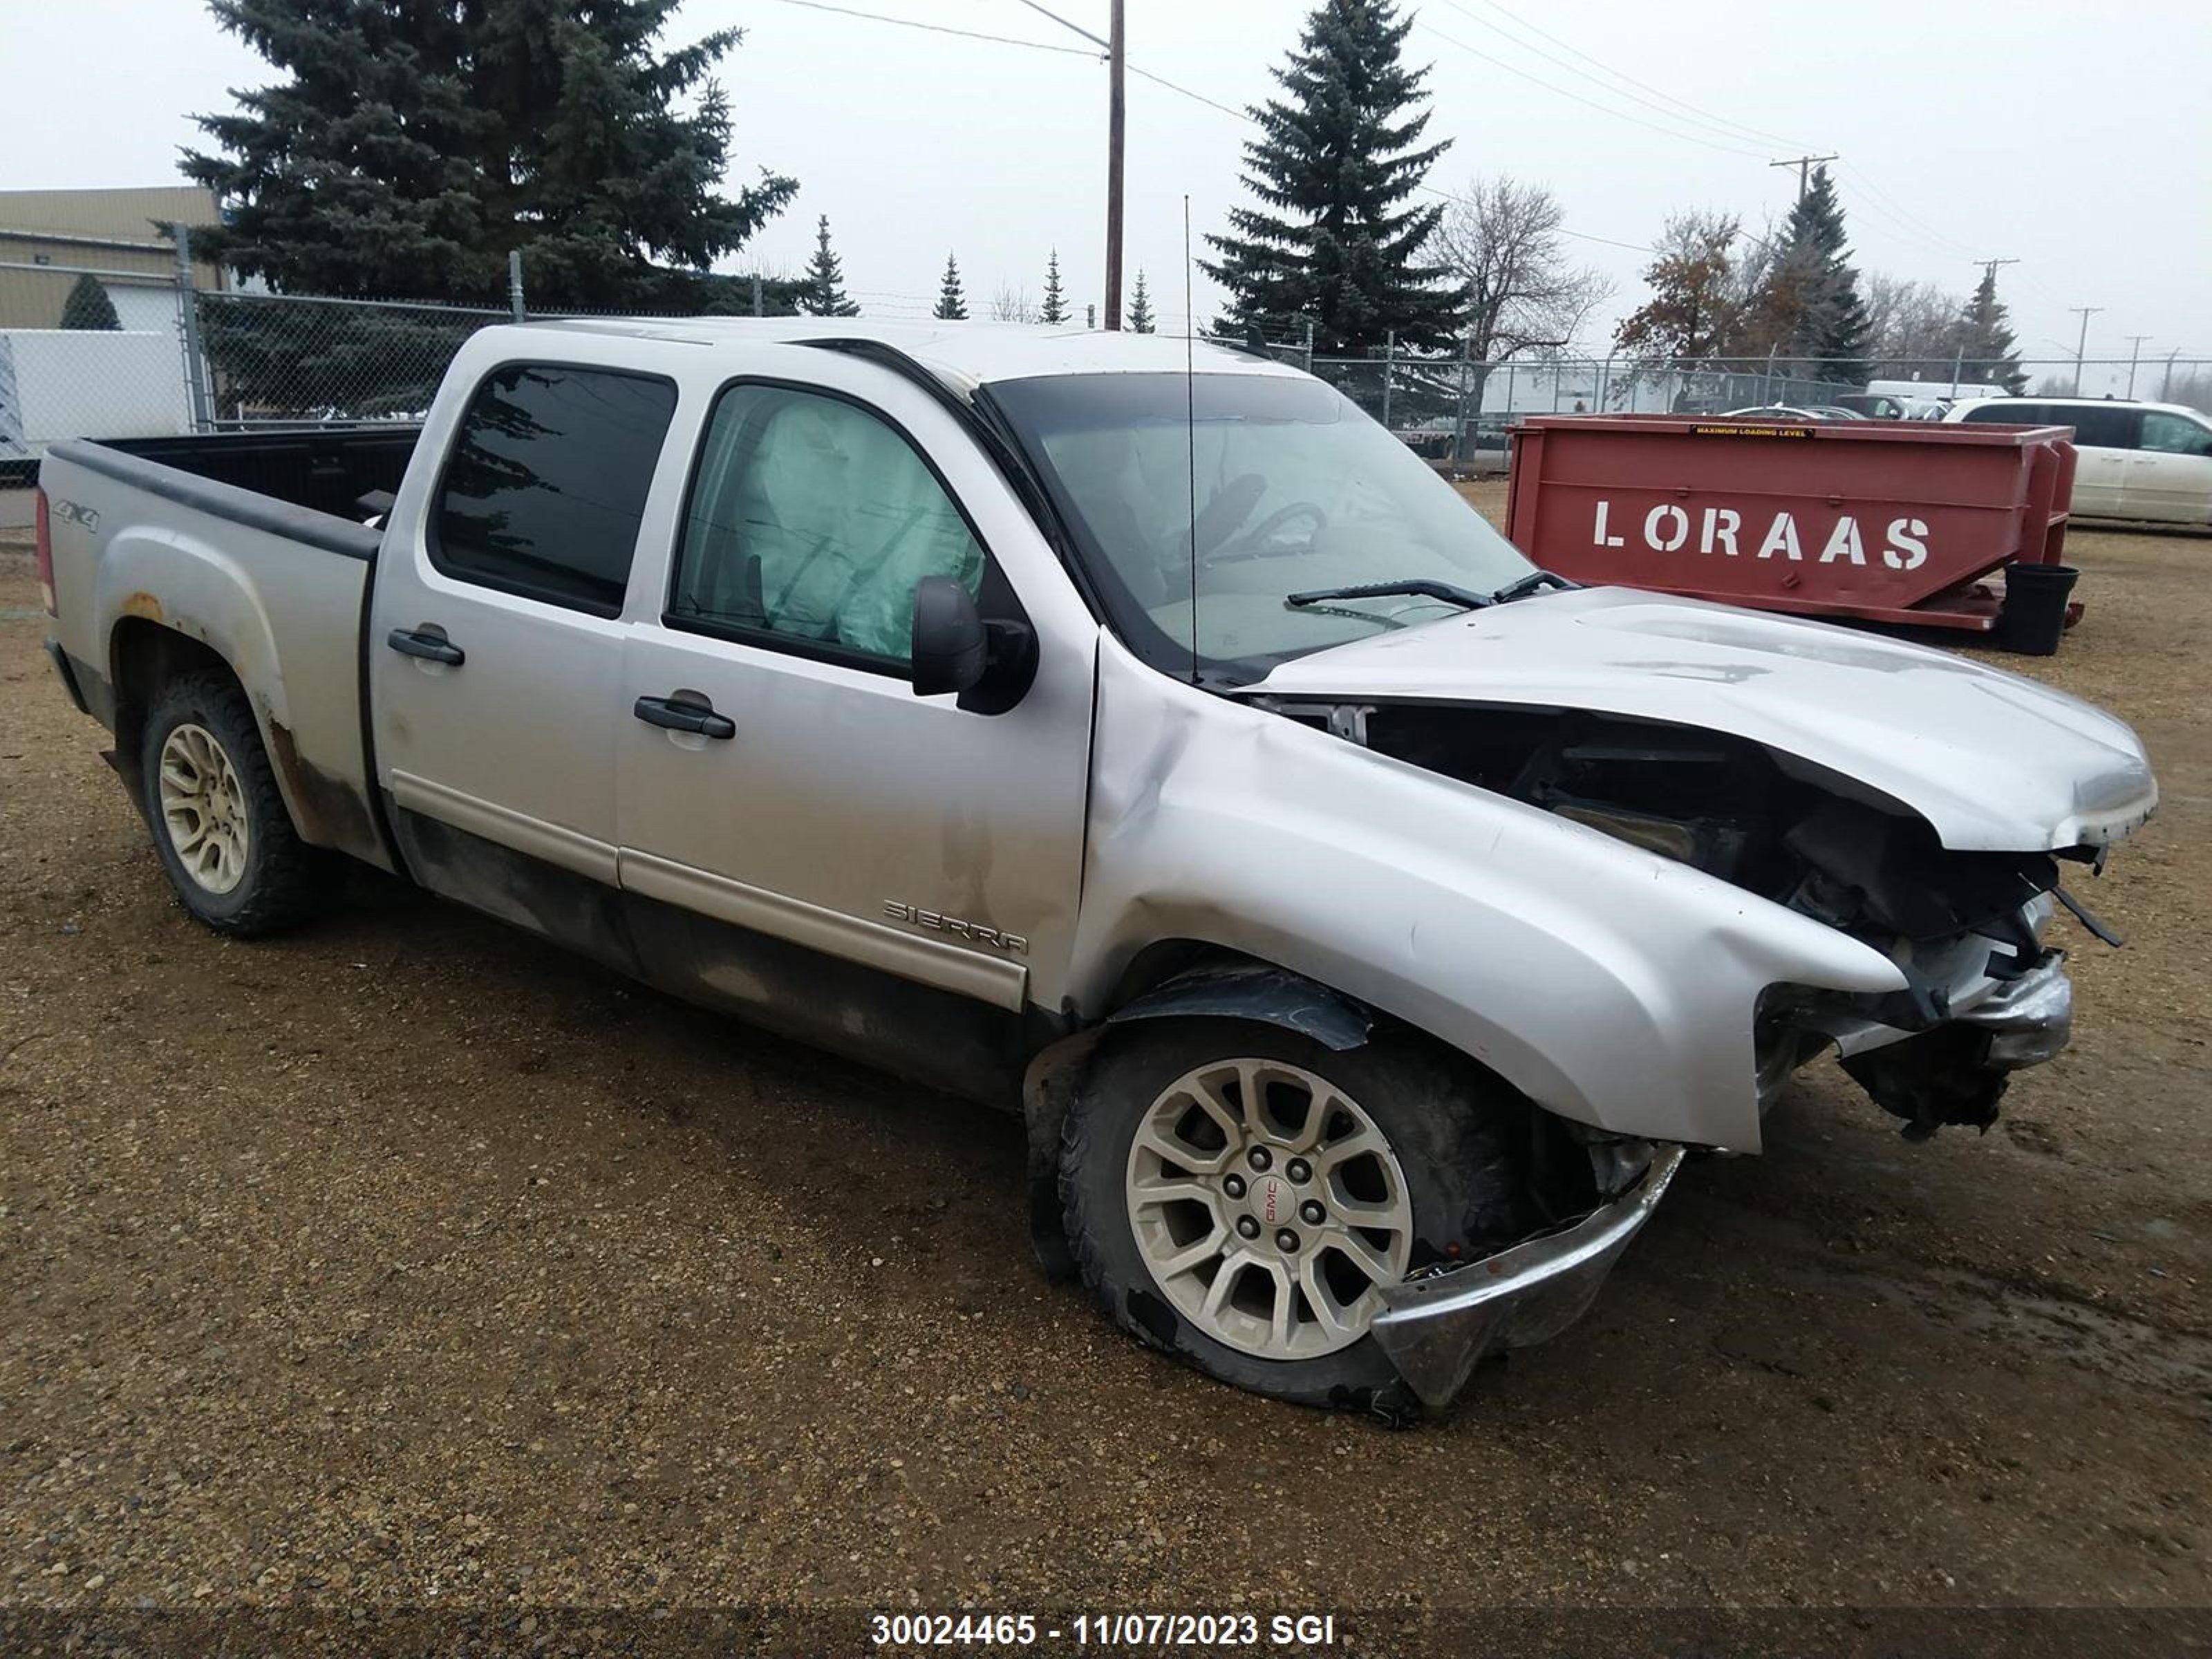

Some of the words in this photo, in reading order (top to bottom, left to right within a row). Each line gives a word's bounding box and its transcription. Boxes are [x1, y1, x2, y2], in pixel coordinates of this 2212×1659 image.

[1696, 427, 1738, 435] MAXIMUM
[1739, 427, 1777, 436] LOADING
[1779, 429, 1806, 438] LEVEL
[1593, 500, 1929, 571] LORAAS
[883, 899, 1029, 955] SIERRA
[1266, 1180, 1277, 1222] GMC
